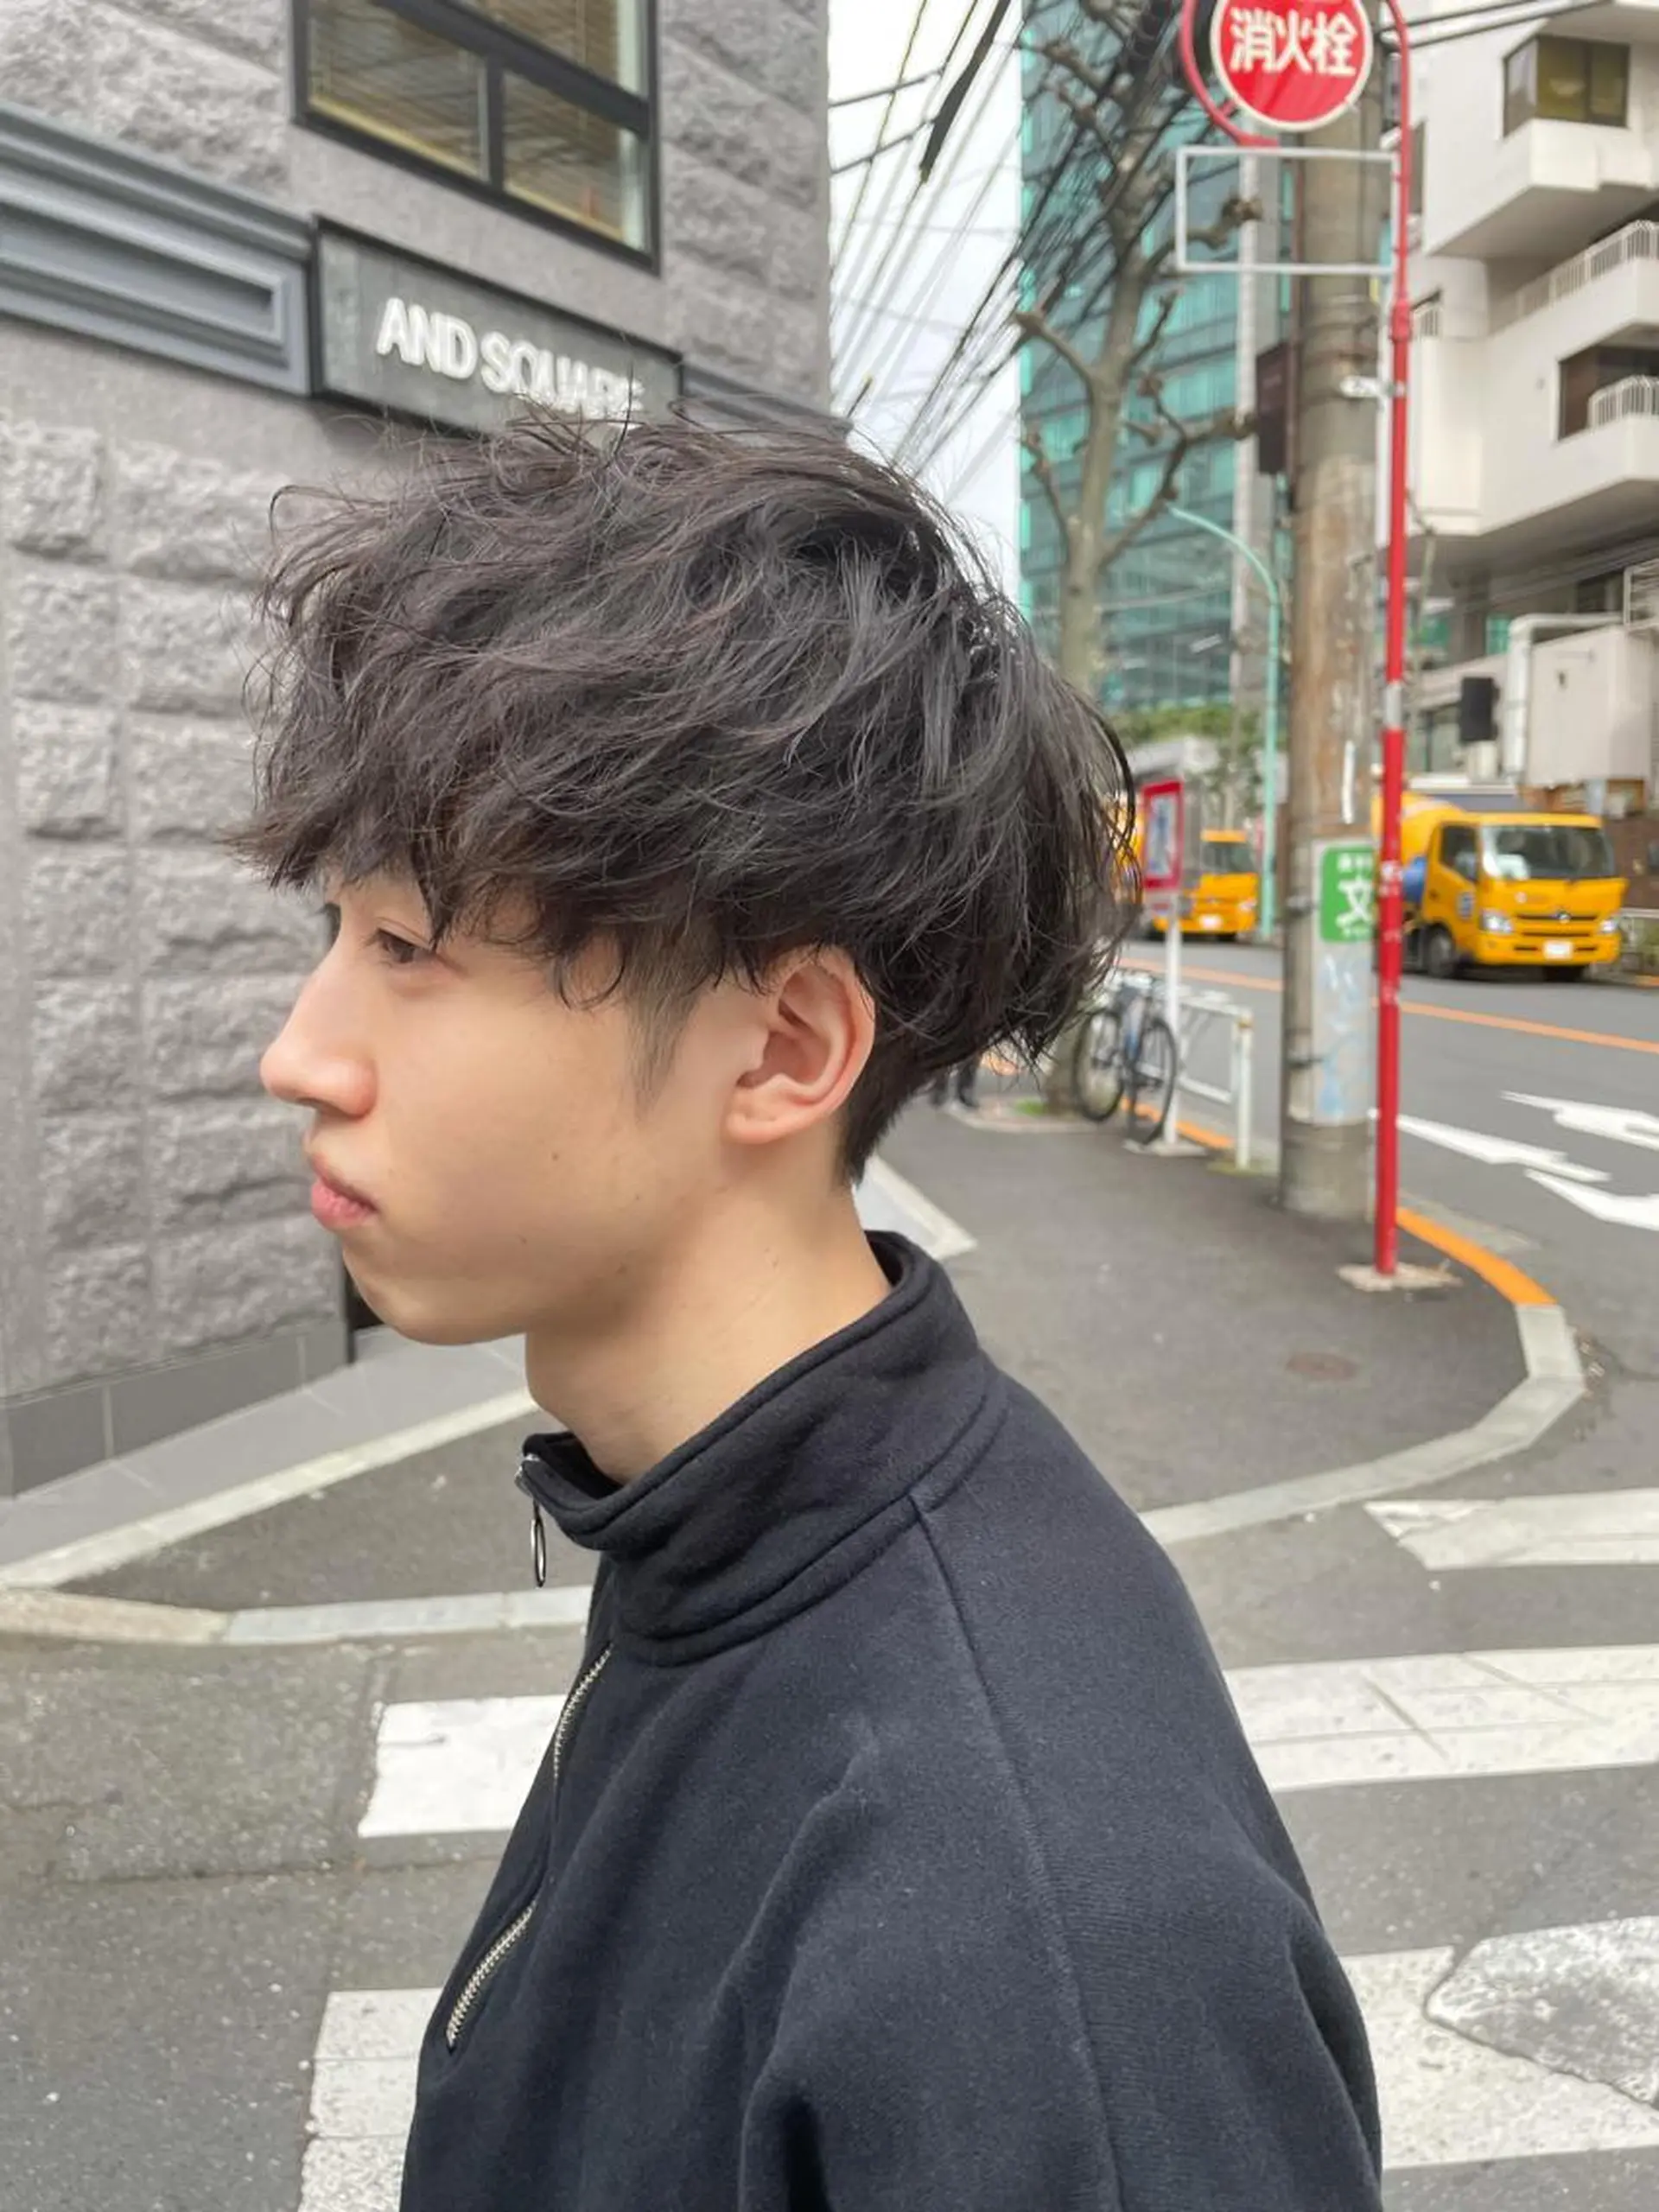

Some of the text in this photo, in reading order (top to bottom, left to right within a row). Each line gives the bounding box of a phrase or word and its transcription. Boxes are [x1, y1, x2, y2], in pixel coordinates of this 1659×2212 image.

[1229, 8, 1357, 76] 消火栓
[378, 297, 477, 379] AND
